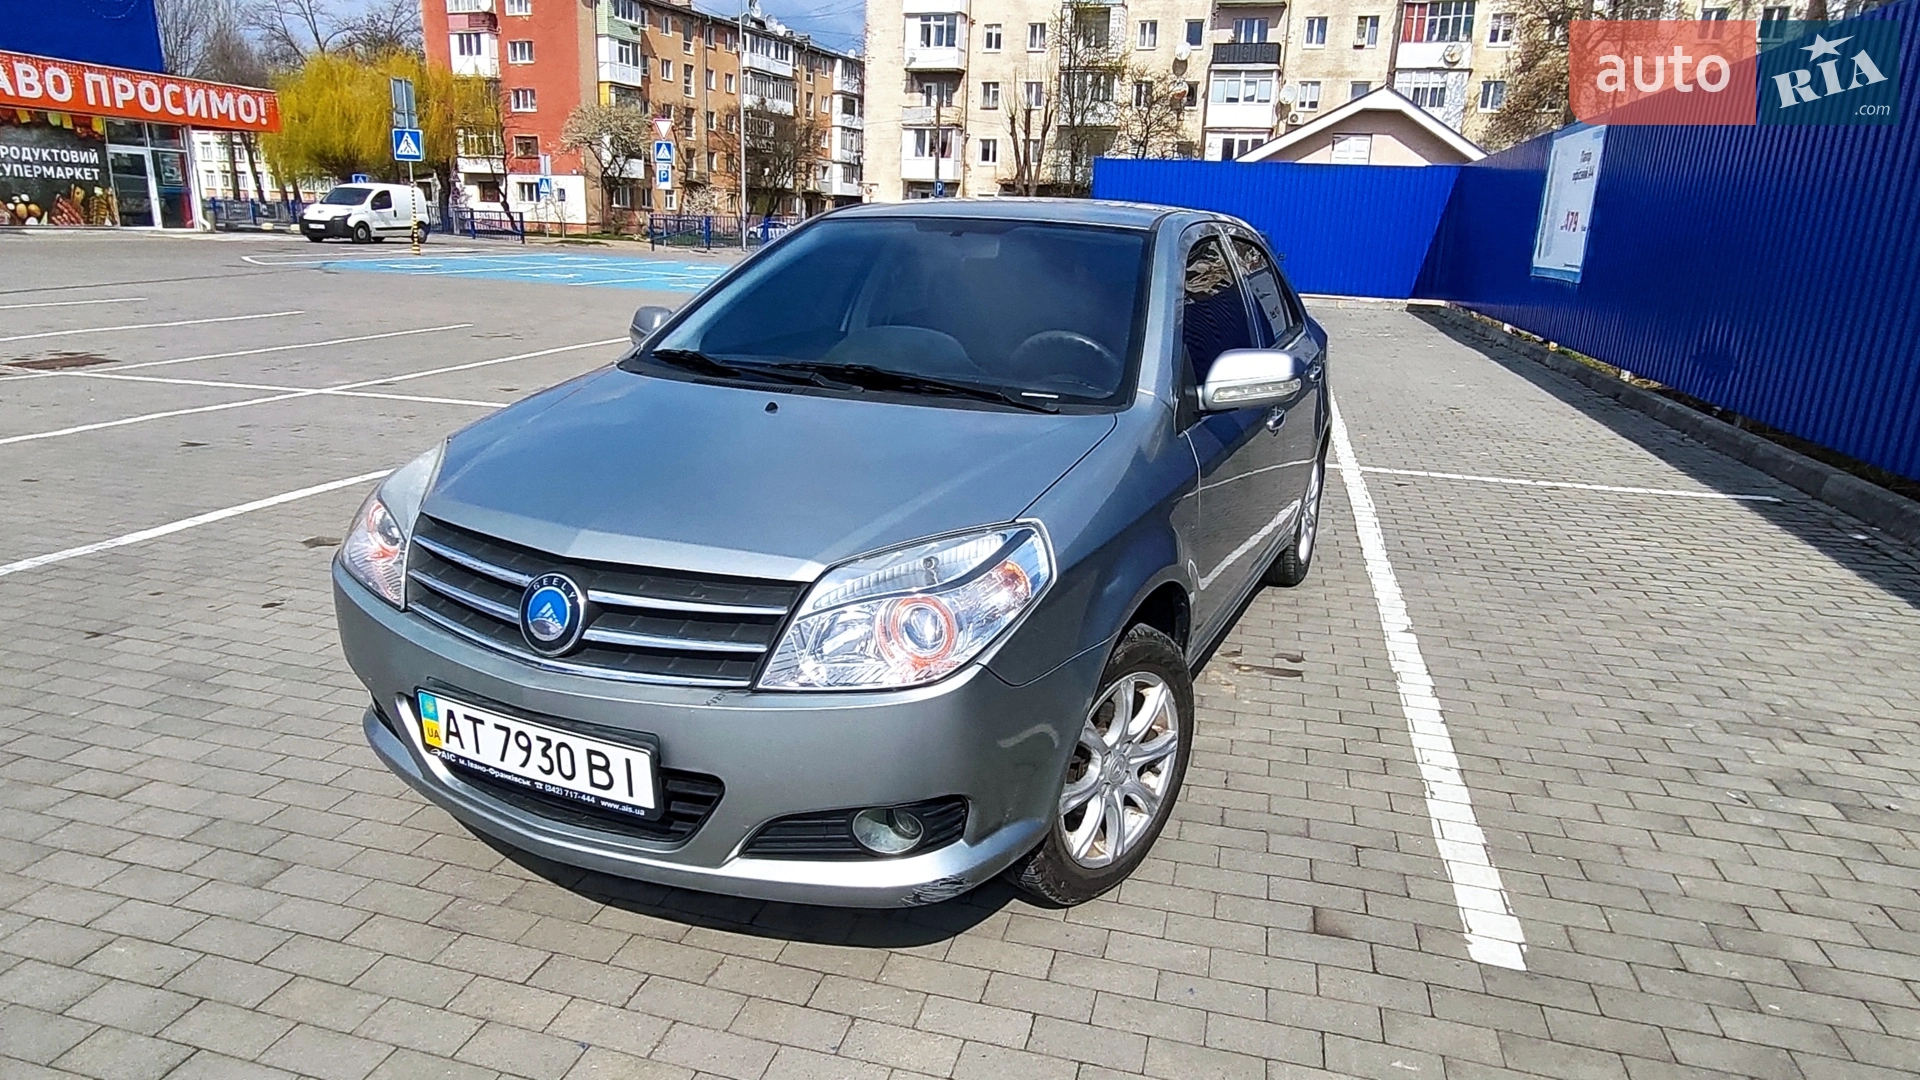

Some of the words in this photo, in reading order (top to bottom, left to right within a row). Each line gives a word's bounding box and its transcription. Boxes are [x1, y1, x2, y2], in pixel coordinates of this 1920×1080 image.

[84, 71, 267, 125] ПРОСИМО!
[533, 577, 576, 598] GEELY
[427, 726, 441, 741] UA
[445, 709, 485, 755] AT
[493, 723, 577, 781] 7930
[586, 748, 634, 798] BI
[563, 789, 596, 804] 717-444
[600, 800, 645, 816] www.ais.ua
